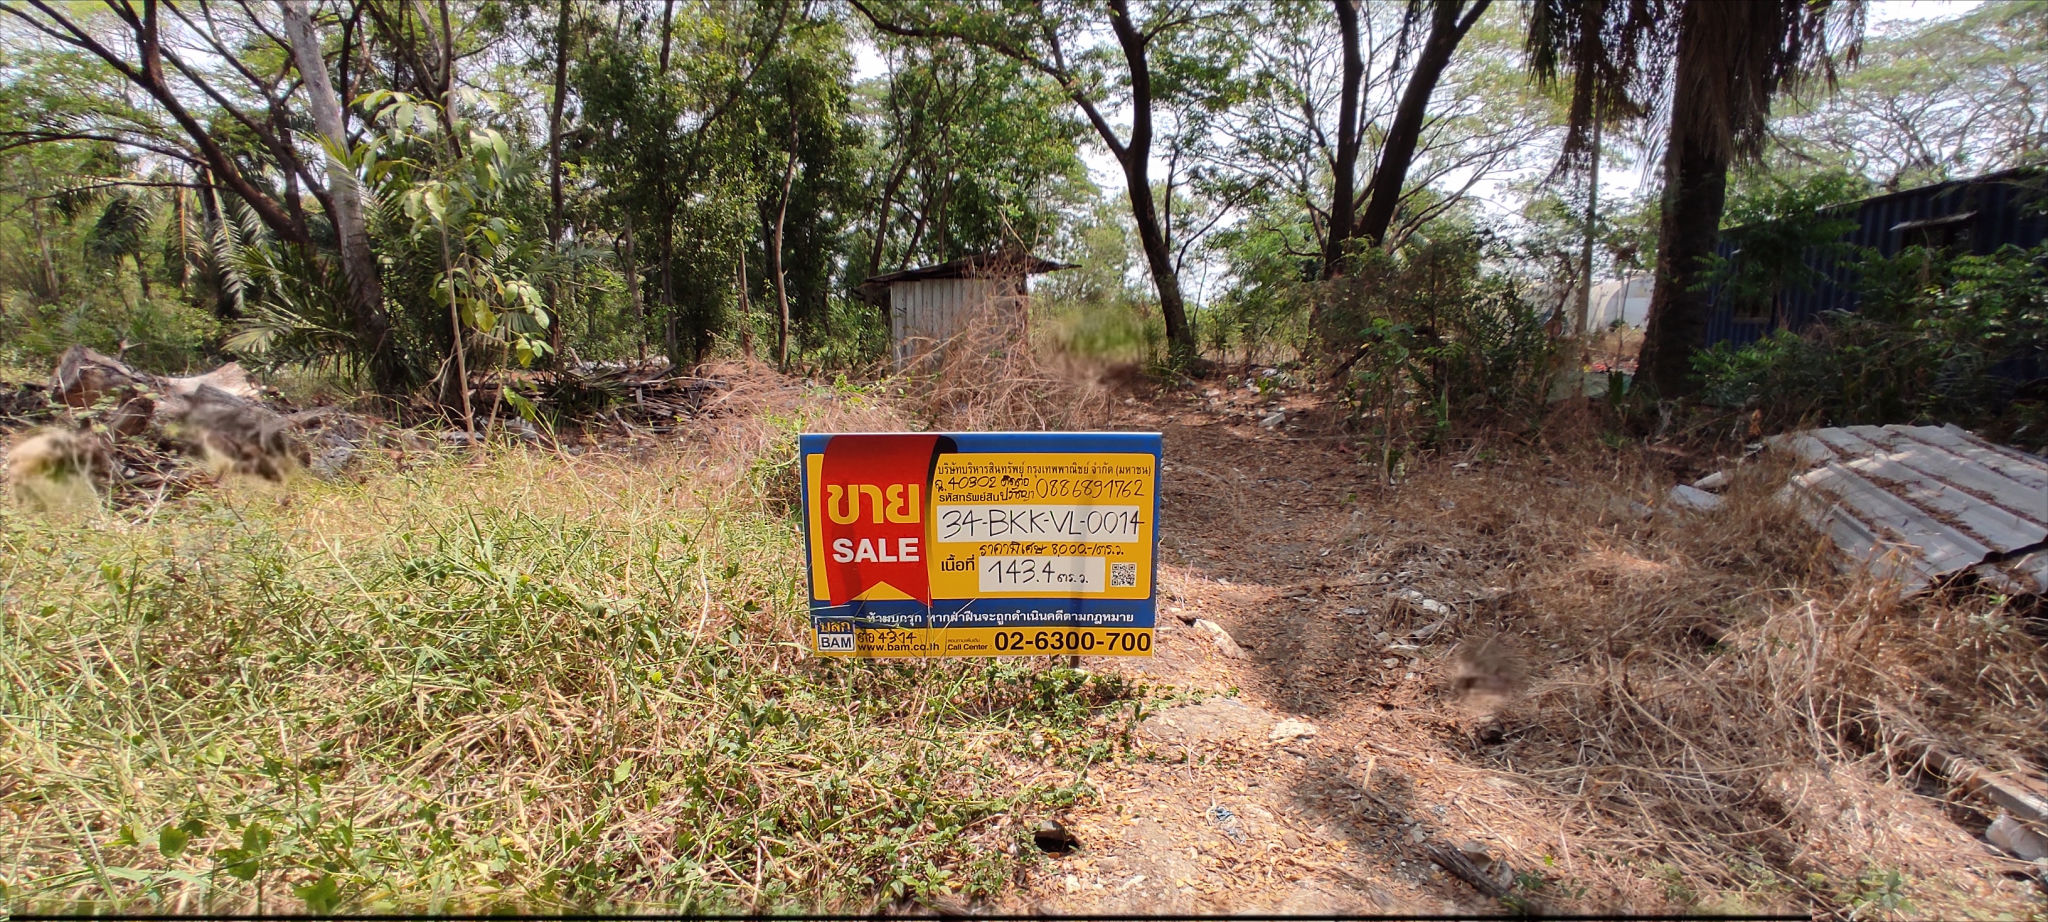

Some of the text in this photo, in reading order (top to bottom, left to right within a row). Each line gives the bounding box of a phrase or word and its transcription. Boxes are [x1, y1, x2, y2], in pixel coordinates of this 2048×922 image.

[938, 461, 1151, 478] บริษัทบริหารสินทรัพย์ กรุงเทพพาณิชย์ จำกัด (มหาชน)
[948, 476, 997, 490] 40302
[1036, 478, 1144, 498] 0886891762
[826, 484, 921, 525] ขาย
[939, 491, 1000, 502] รหัสทรัพย์สิน
[942, 509, 1145, 539] 34-BKK-VL-0014
[832, 537, 920, 563] SALE
[979, 541, 1048, 557] ราคาพิเศษ
[941, 554, 975, 572] เนื้อที่
[988, 559, 1055, 584] 143.4
[866, 612, 922, 627] ห้ามบุกรุก
[821, 636, 852, 648] BAM
[947, 643, 962, 651] Call
[963, 643, 988, 651] Center
[994, 631, 1152, 652] 02-6300-700
